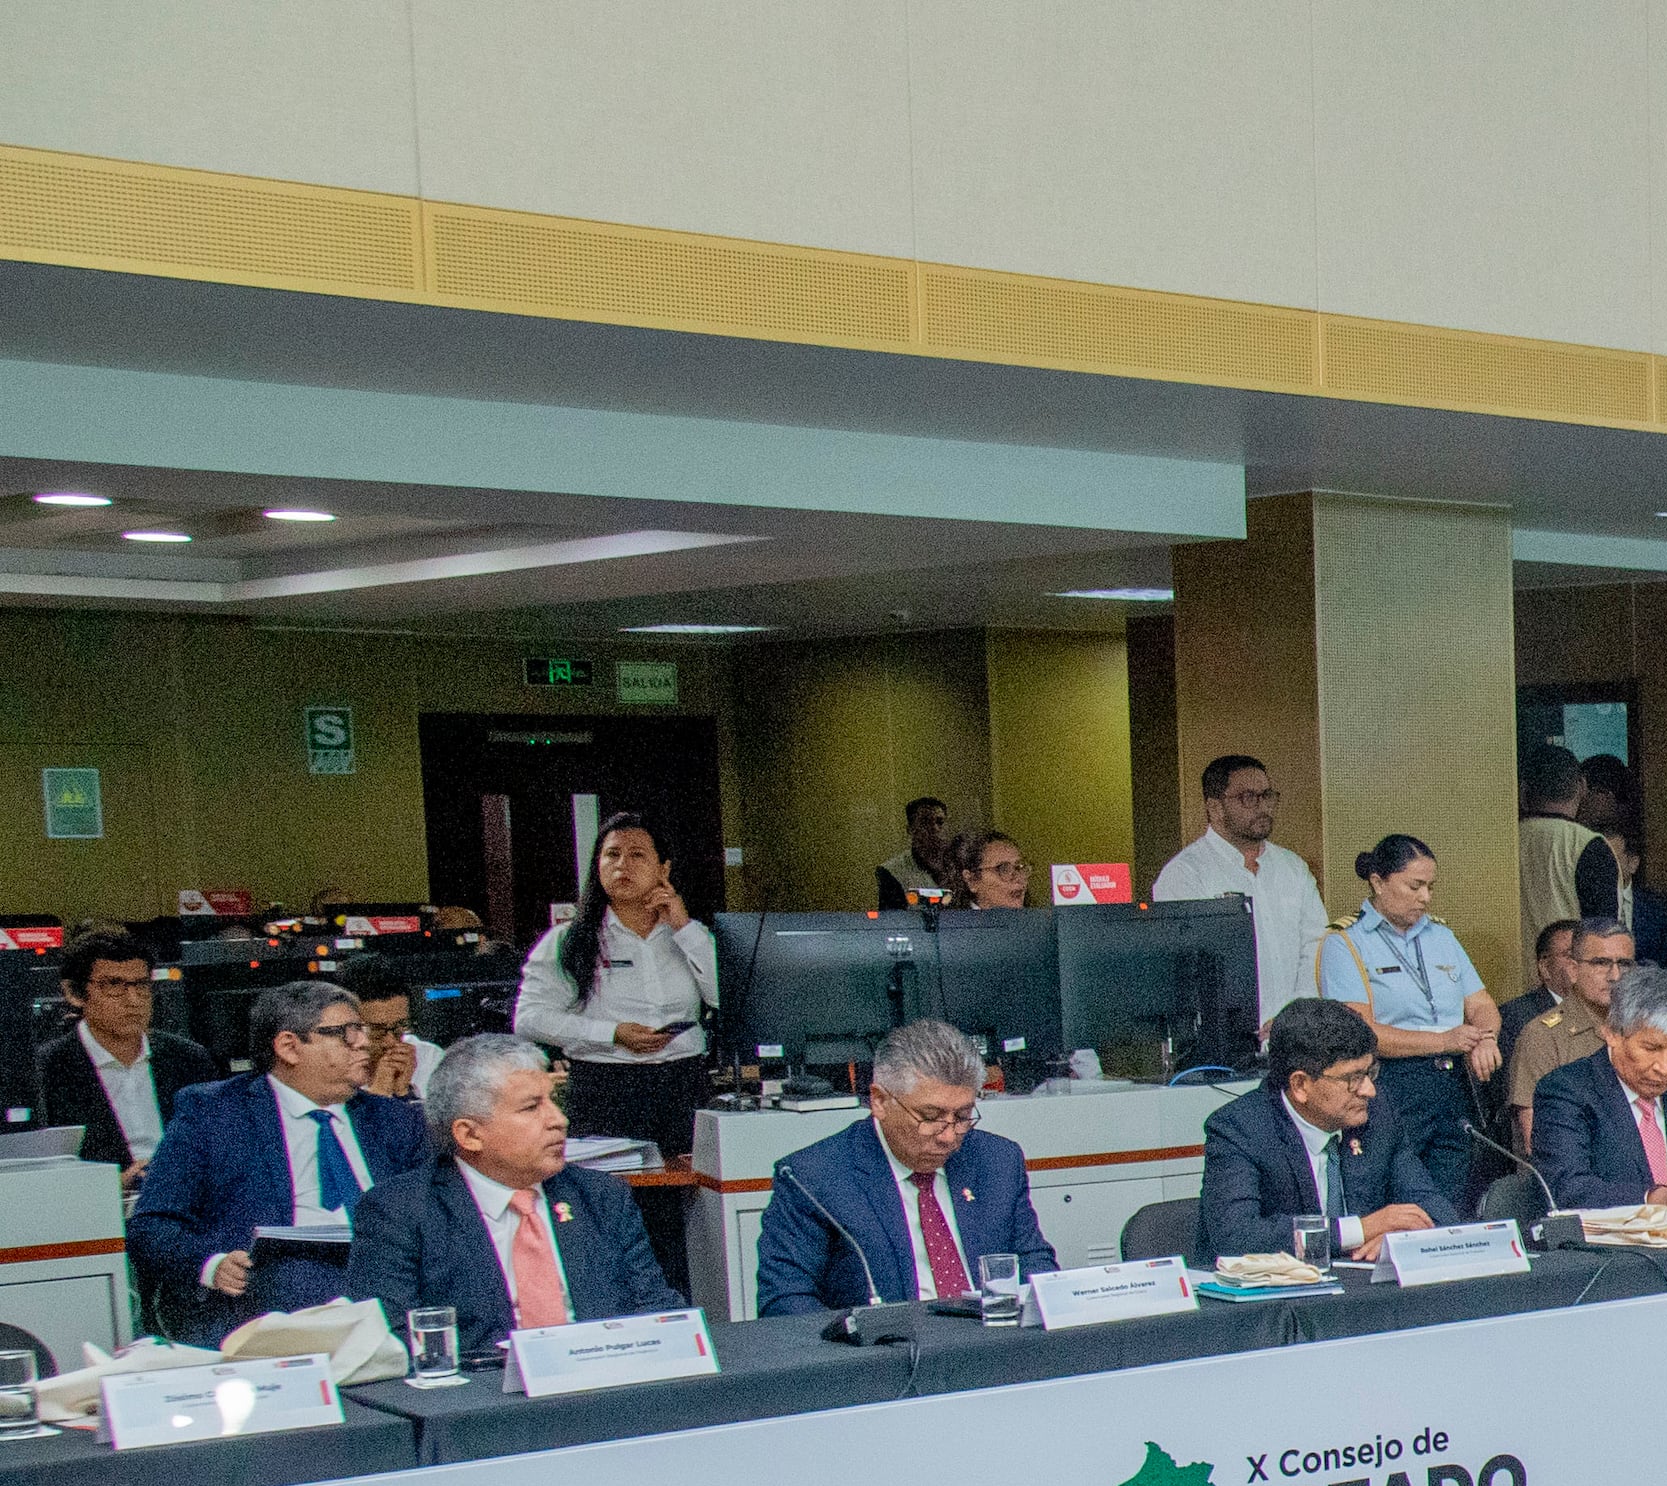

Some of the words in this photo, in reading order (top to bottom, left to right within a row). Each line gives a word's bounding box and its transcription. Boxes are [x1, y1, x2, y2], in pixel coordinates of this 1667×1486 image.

[312, 713, 347, 746] S
[1246, 1454, 1269, 1483] X
[1280, 1436, 1402, 1478] Consejo
[1413, 1426, 1449, 1454] de
